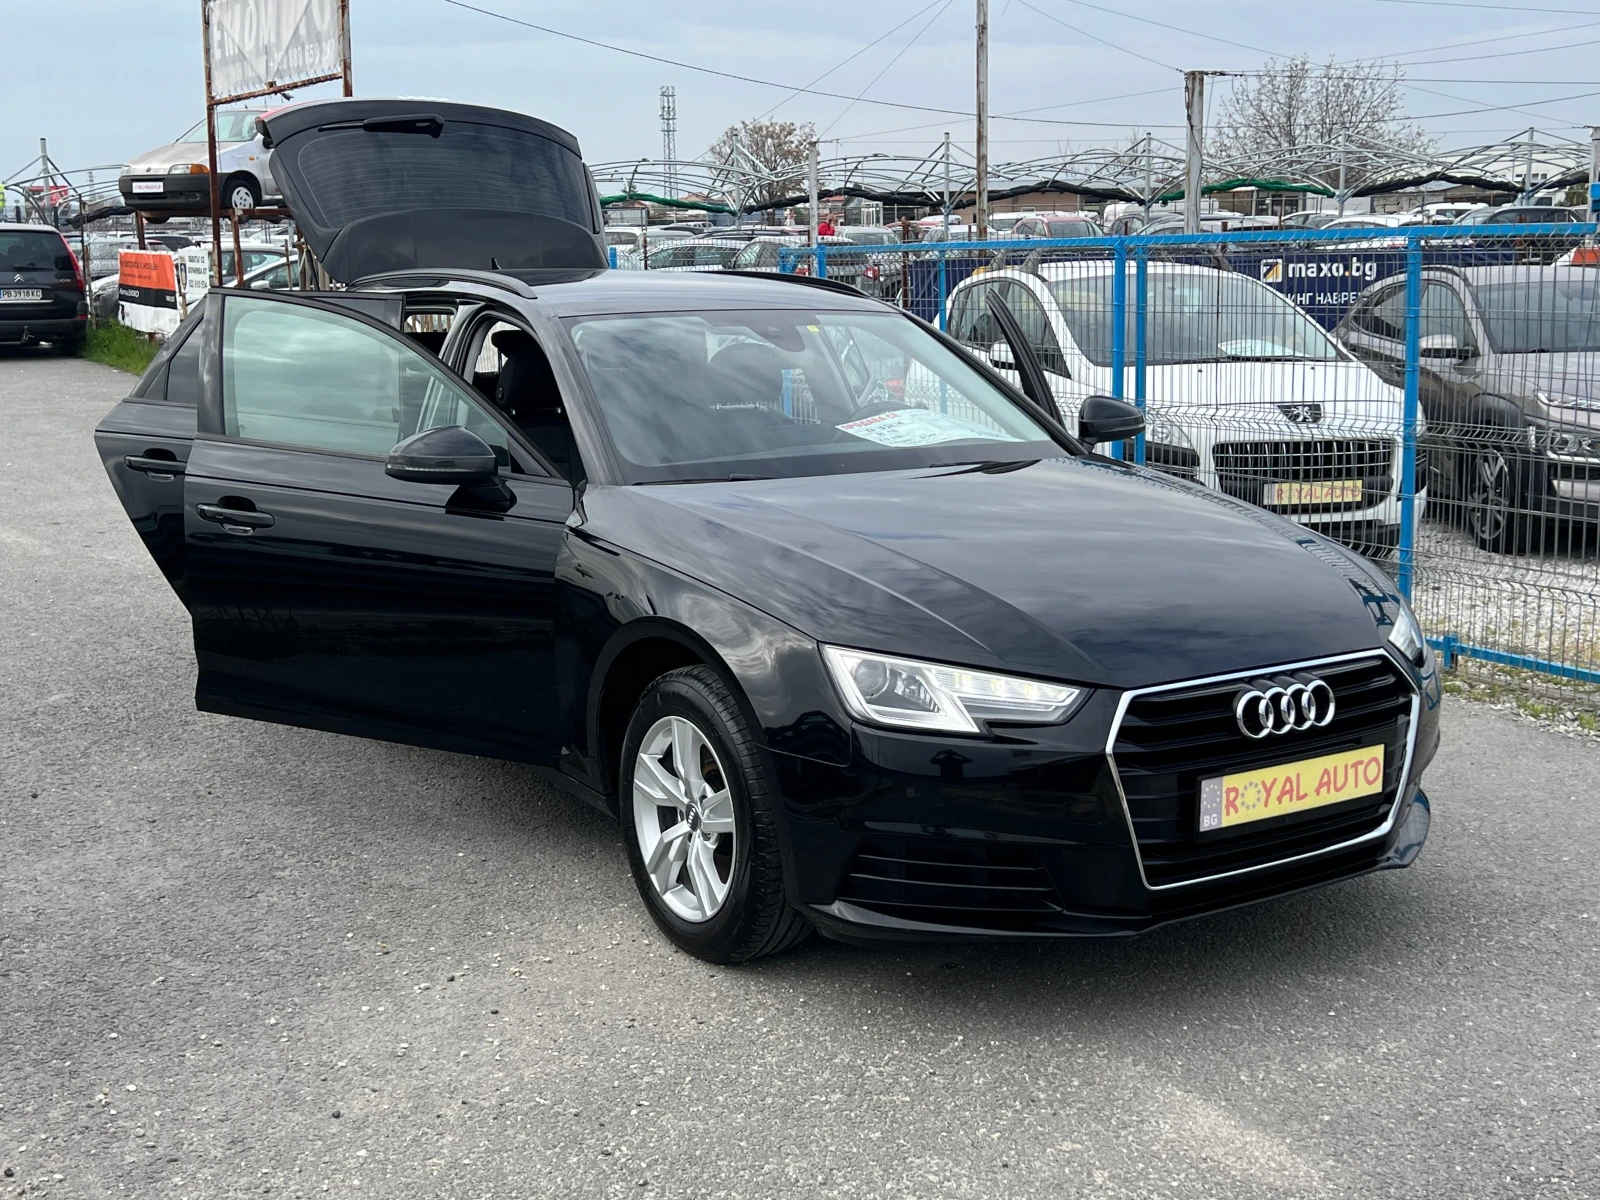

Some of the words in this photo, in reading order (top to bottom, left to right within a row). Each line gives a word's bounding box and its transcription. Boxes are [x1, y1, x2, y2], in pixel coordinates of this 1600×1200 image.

[1288, 257, 1377, 281] maxo.bg
[13, 290, 31, 298] 3918
[1315, 292, 1362, 305] НАВРЕ
[841, 413, 886, 430] ПРОДАВА
[1314, 756, 1382, 797] AUTO
[1203, 813, 1218, 828] BG
